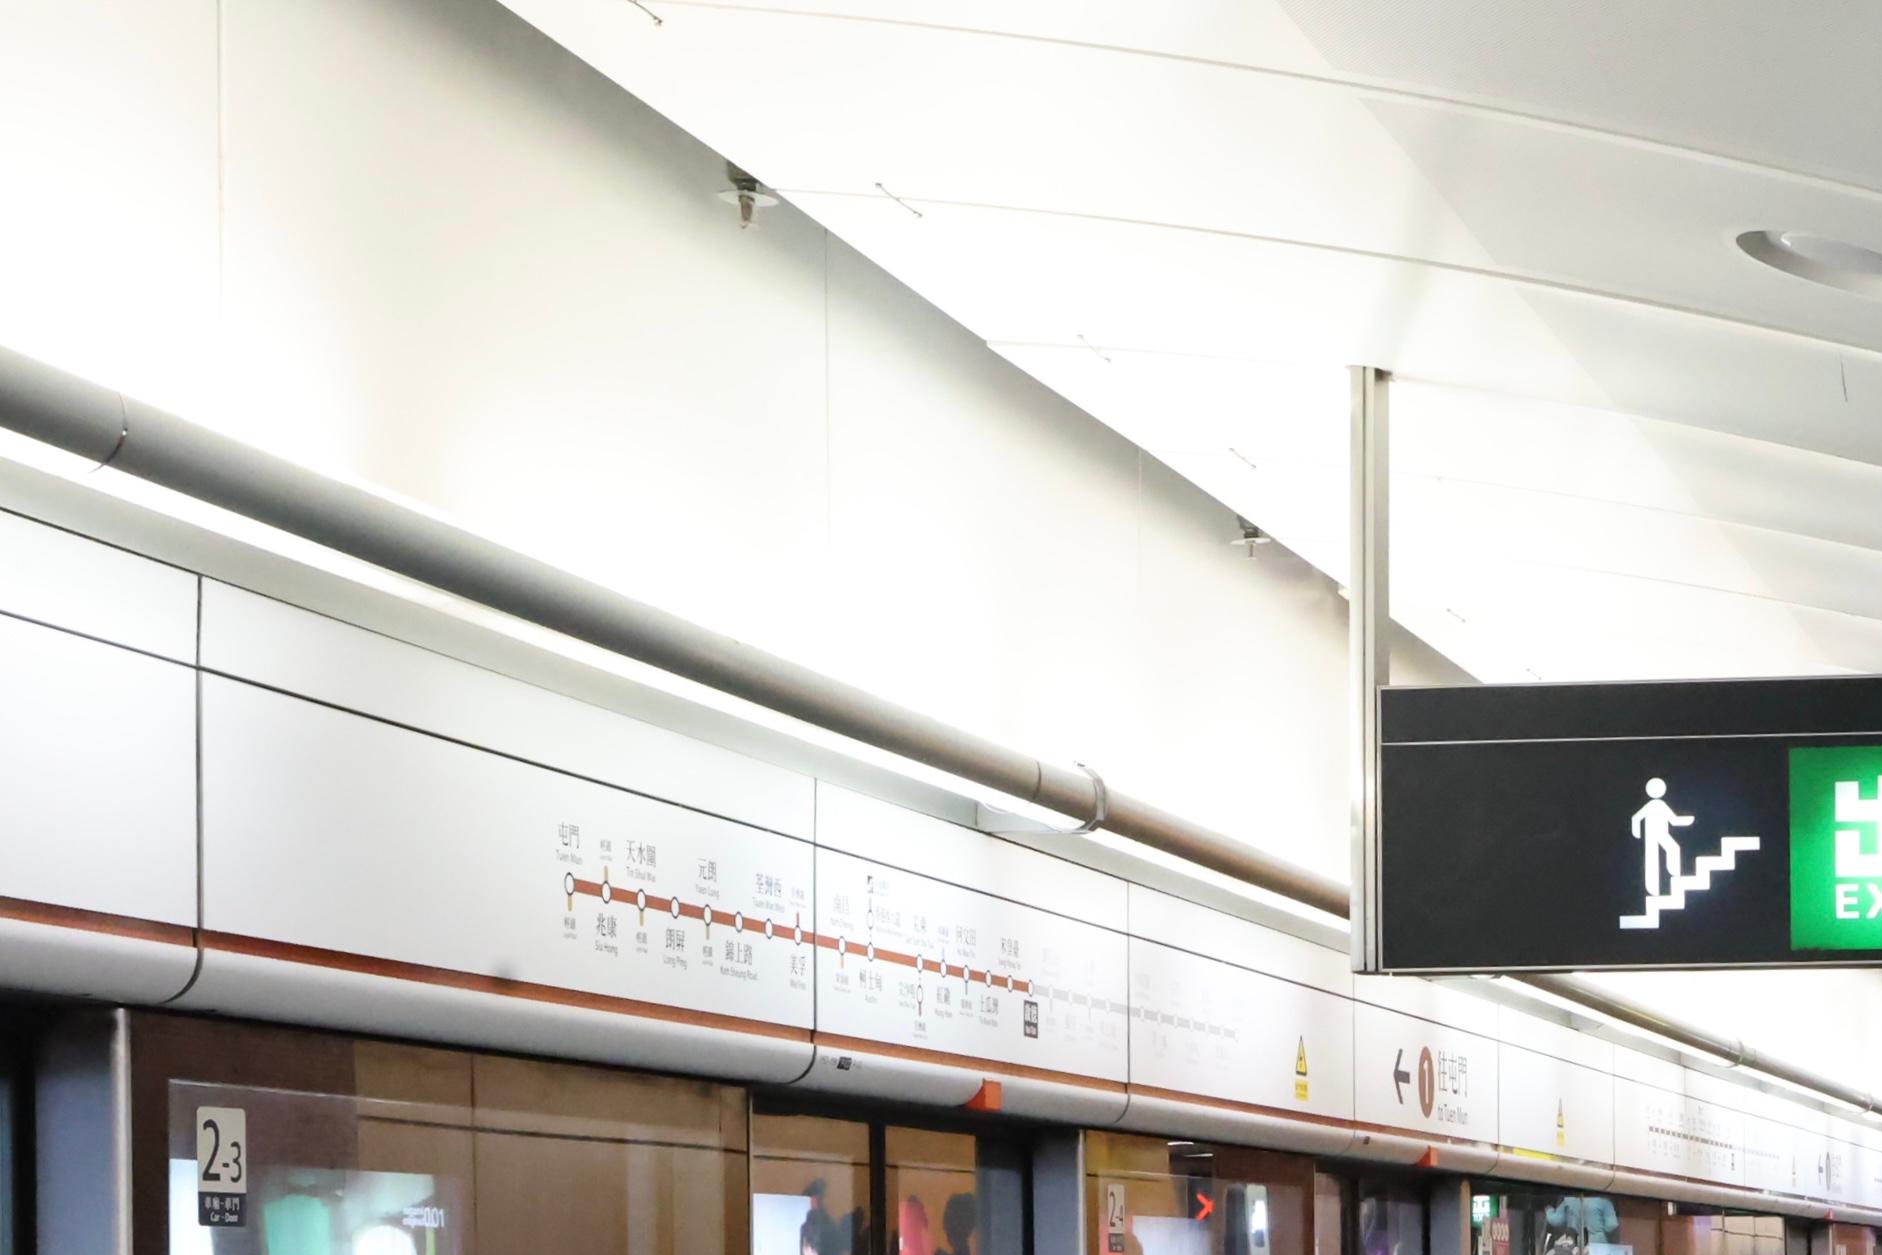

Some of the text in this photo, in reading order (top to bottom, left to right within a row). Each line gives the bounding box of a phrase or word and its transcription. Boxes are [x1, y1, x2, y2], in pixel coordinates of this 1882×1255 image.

[1437, 1049, 1468, 1098] 往屯門
[202, 1119, 242, 1183] 2-3
